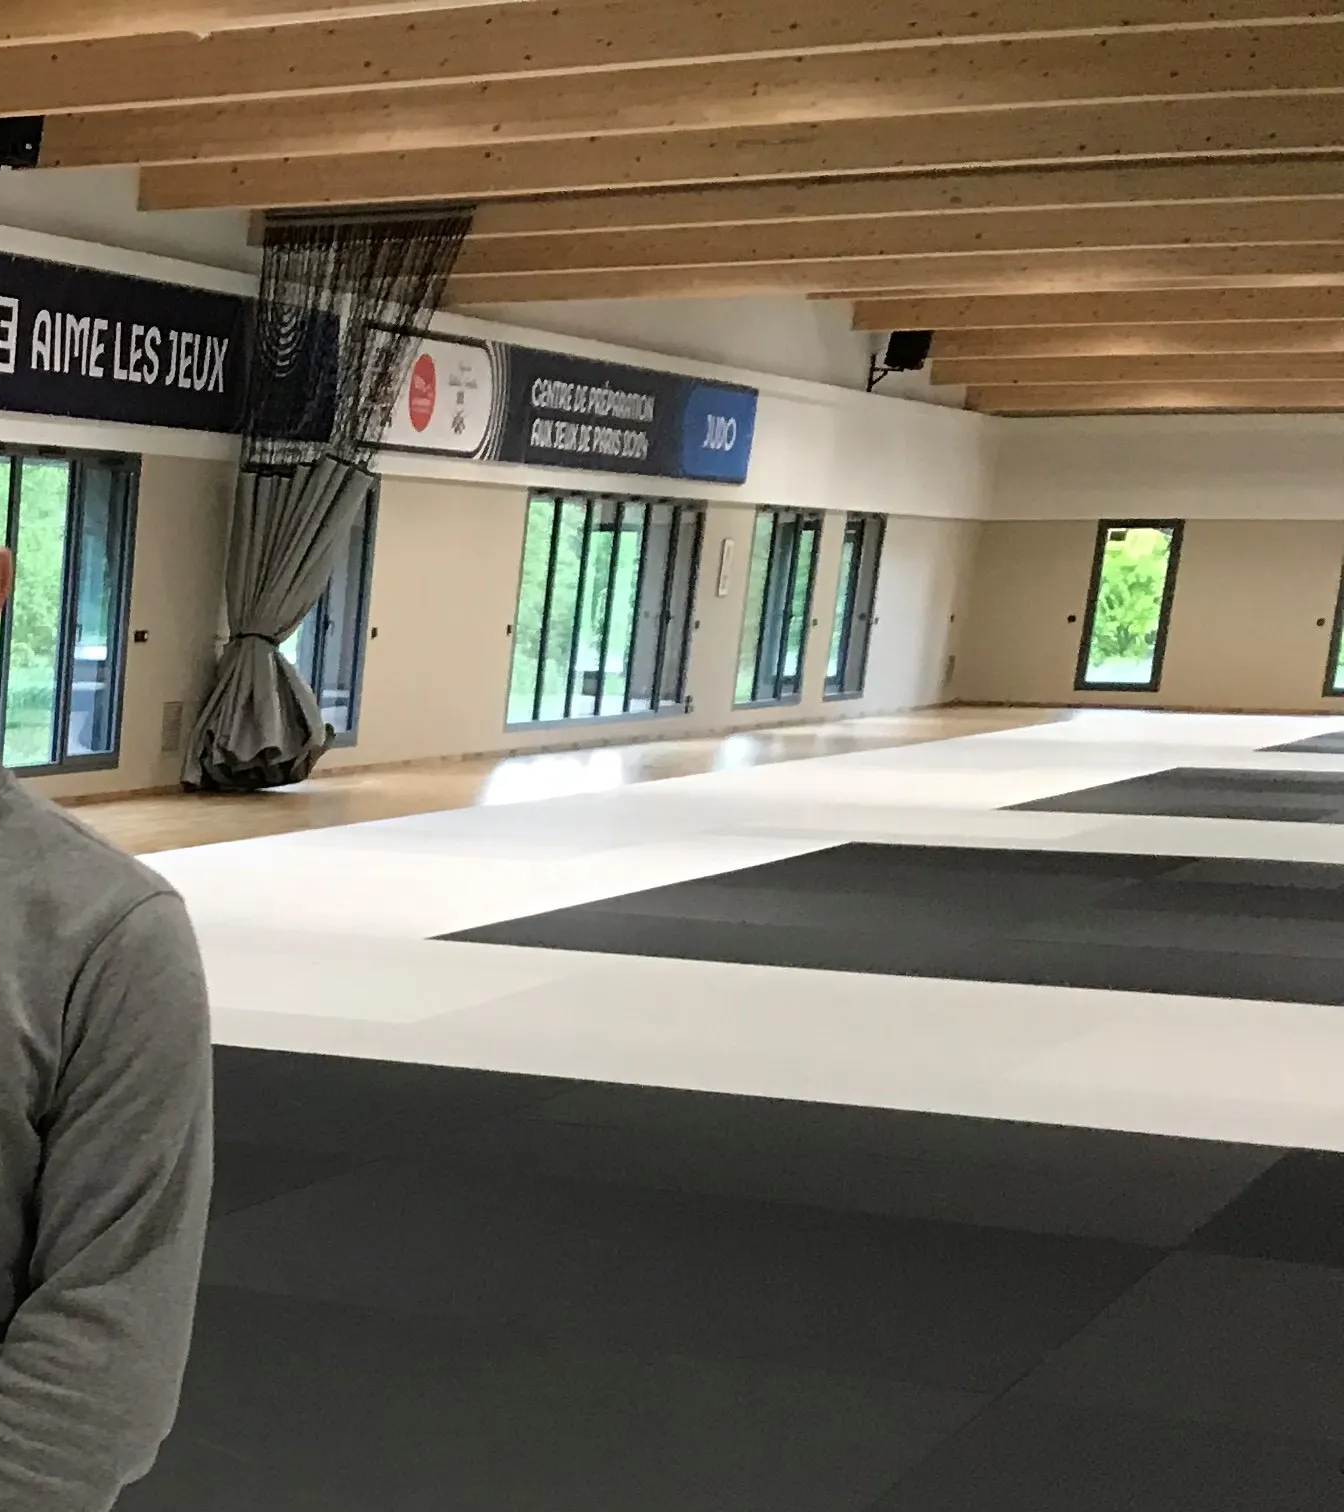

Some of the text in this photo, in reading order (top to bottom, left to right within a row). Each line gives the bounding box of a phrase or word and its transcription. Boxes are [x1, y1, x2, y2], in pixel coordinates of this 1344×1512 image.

[30, 308, 108, 380] AIME
[113, 321, 160, 385] LES
[165, 329, 230, 394] JEUX
[702, 413, 737, 452] JUDO
